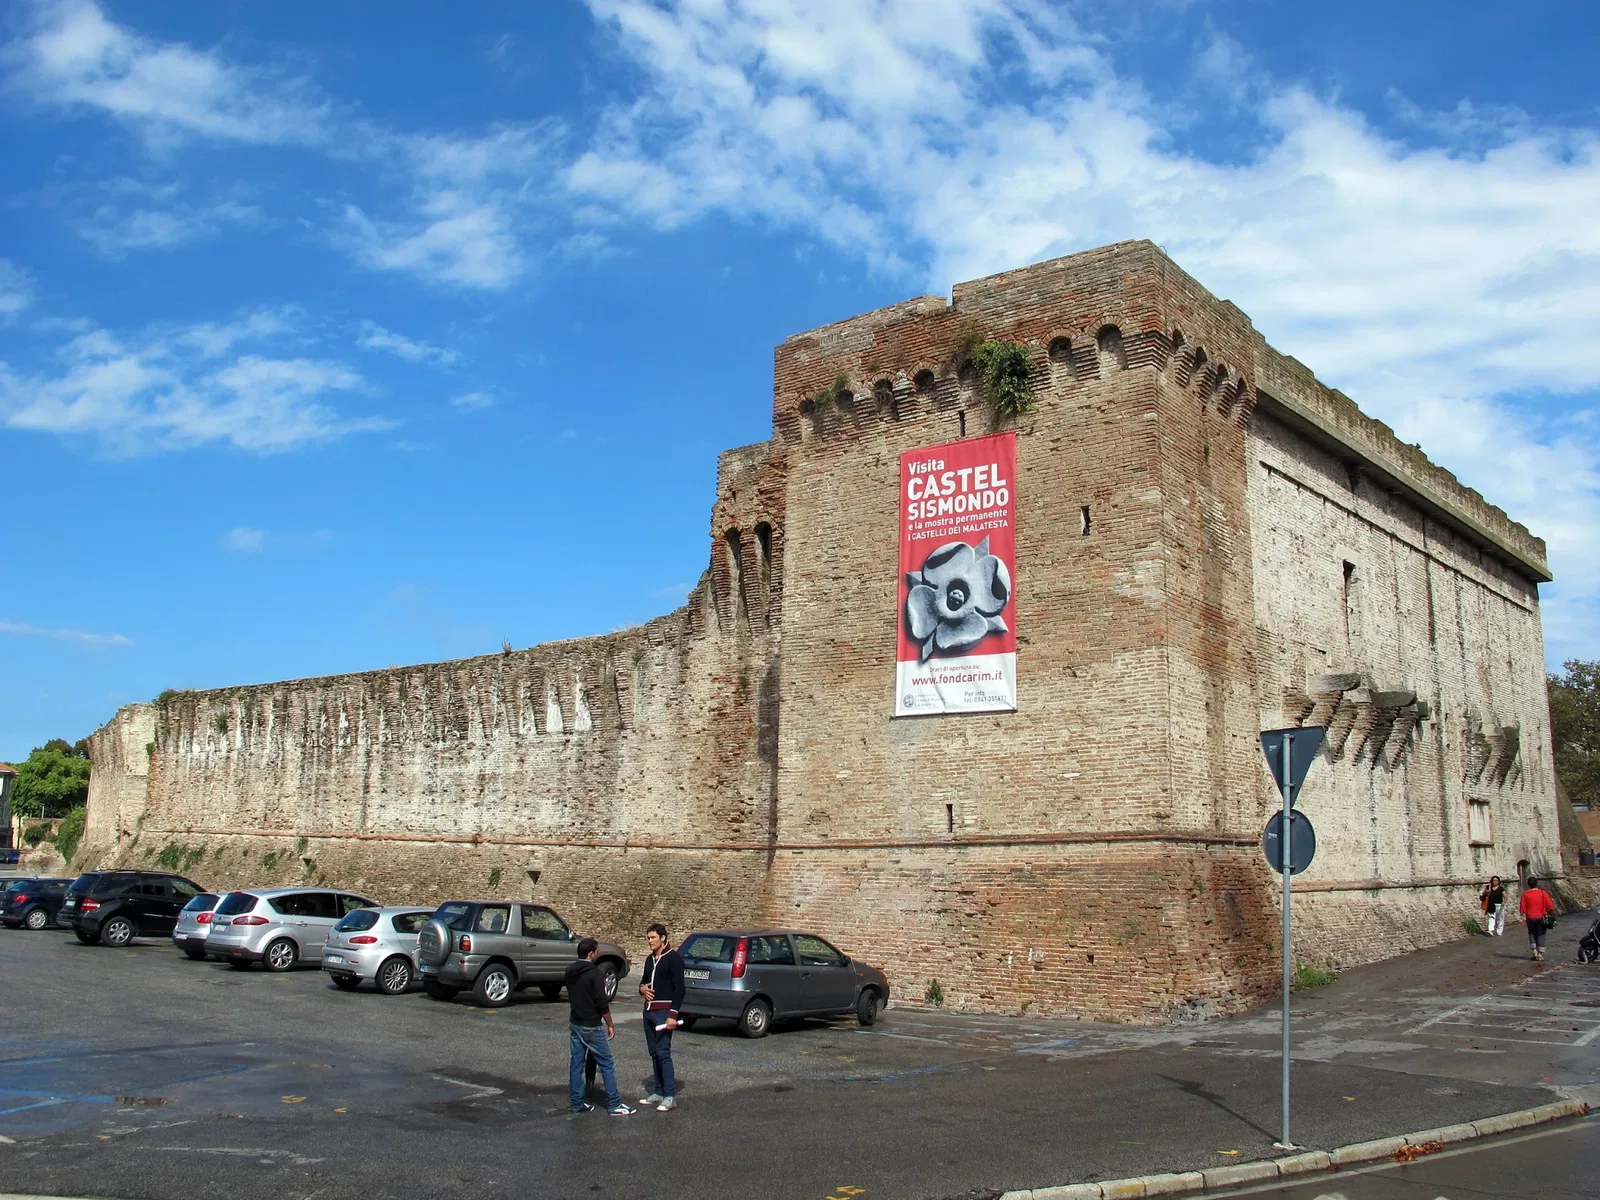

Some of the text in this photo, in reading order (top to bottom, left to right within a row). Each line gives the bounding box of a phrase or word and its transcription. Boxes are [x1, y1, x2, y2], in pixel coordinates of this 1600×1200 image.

[908, 459, 945, 475] Visita
[907, 463, 1006, 501] CASTEL
[907, 488, 1009, 521] SISMONDO
[914, 520, 923, 529] la
[925, 517, 954, 528] mostra
[956, 509, 1008, 526] permanente
[908, 519, 1009, 541] I CASTELLI DEI MALATESTA
[912, 670, 1002, 685] www.fondcarim.it
[949, 664, 971, 672] apertura
